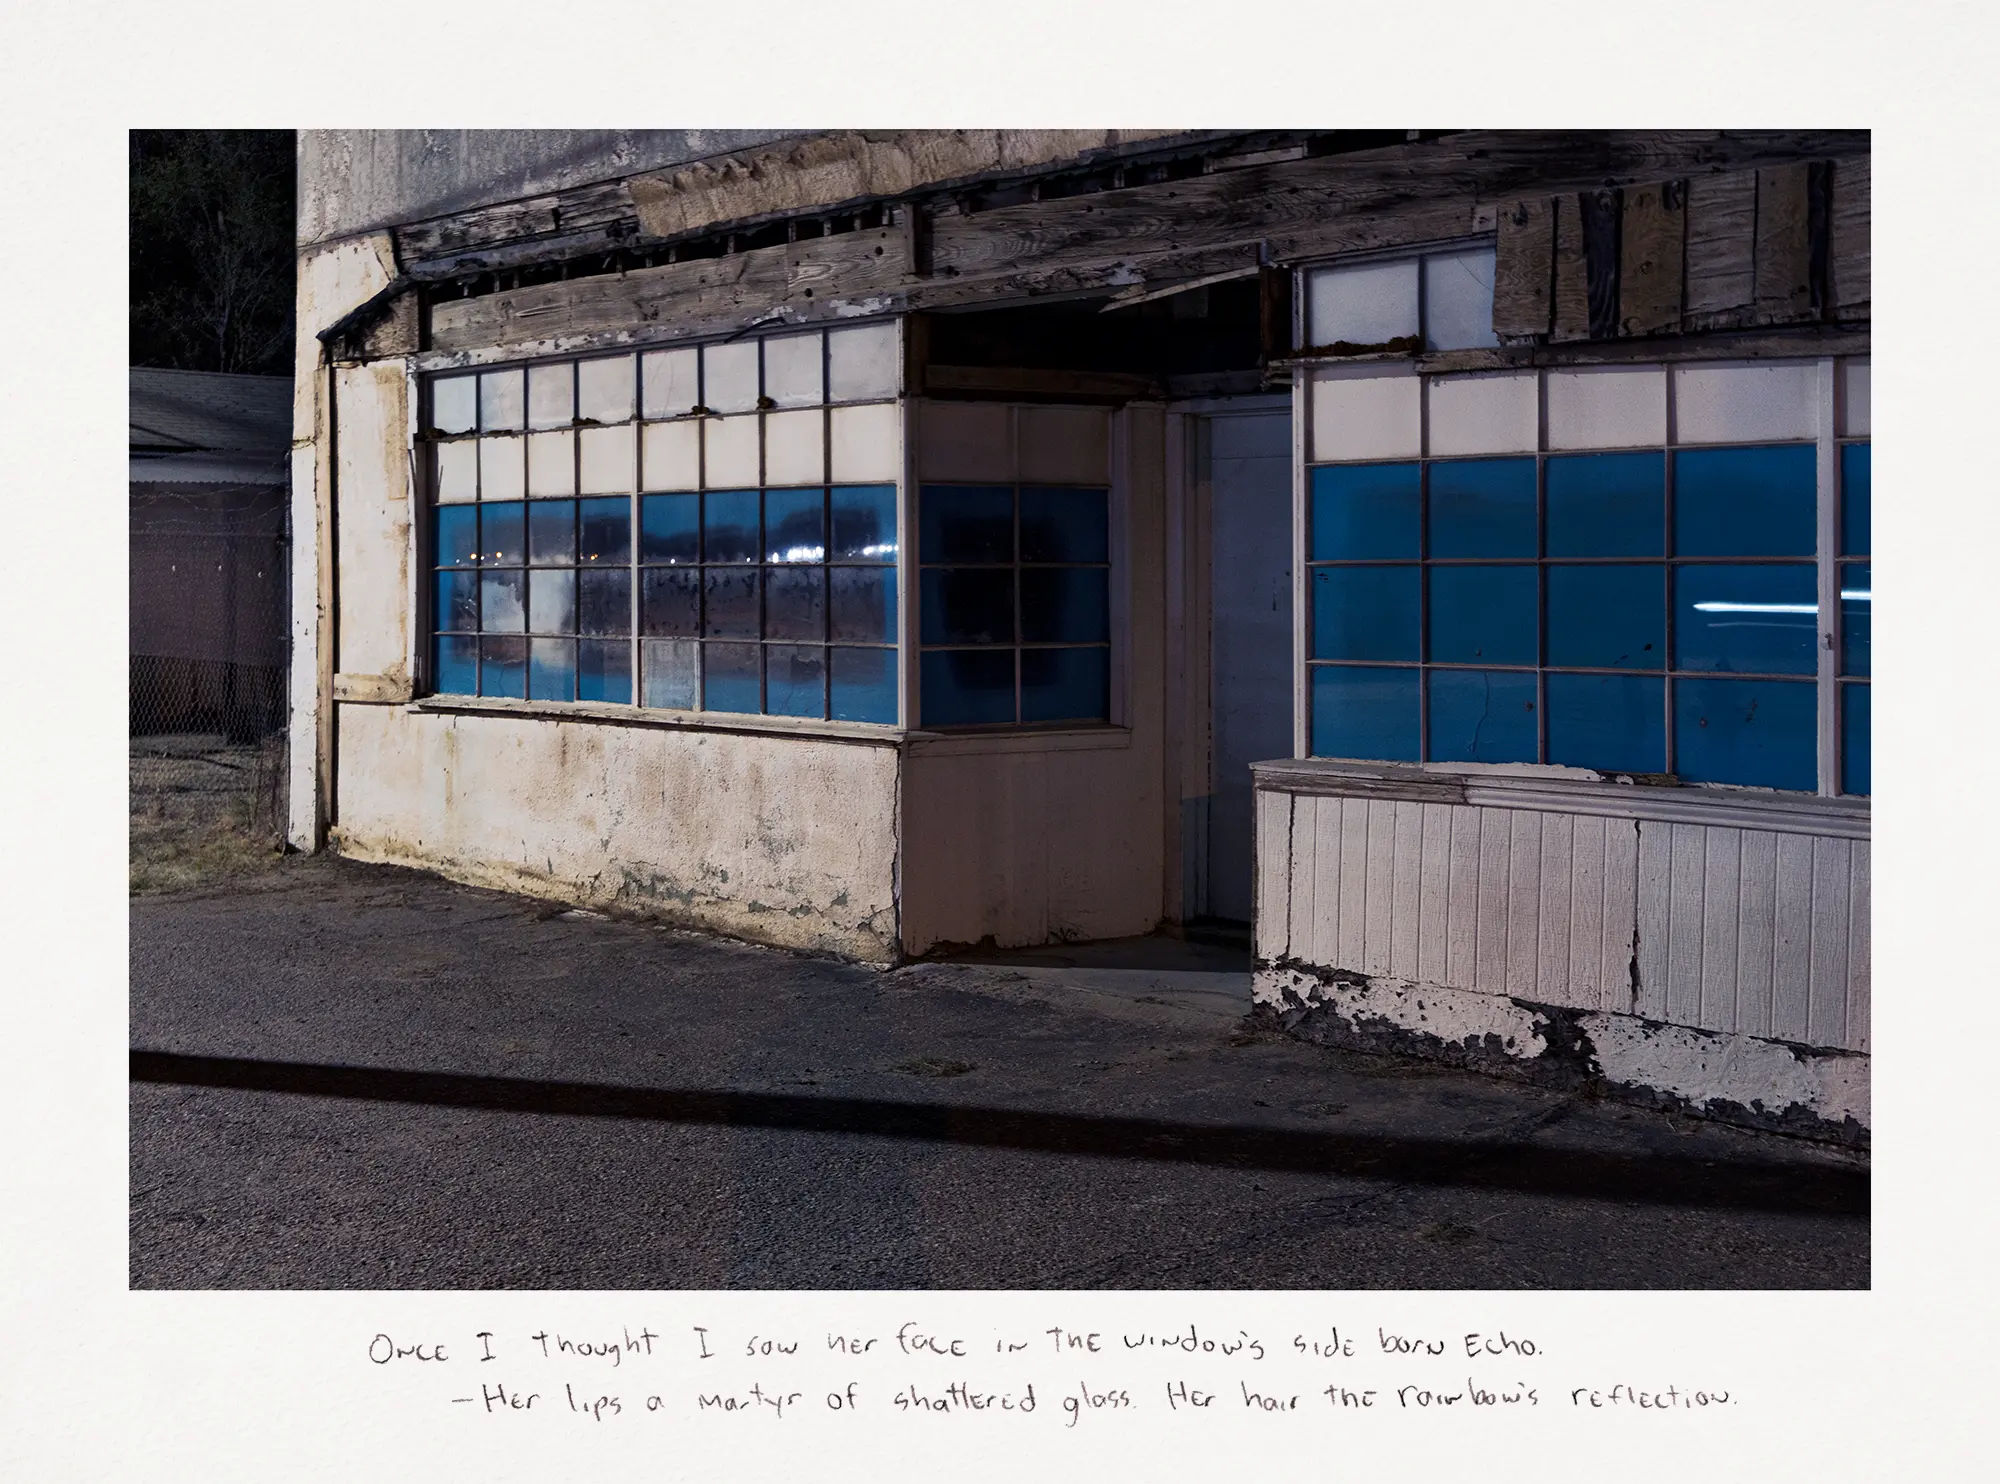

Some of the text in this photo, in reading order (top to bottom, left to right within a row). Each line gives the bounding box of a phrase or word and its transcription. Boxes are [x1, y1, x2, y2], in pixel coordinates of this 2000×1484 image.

[475, 1331, 497, 1363] I
[531, 1325, 660, 1368] thought
[692, 1326, 716, 1360] I
[745, 1335, 799, 1357] saw
[827, 1332, 879, 1355] her
[895, 1321, 967, 1357] face
[993, 1327, 1028, 1353] in
[1293, 1326, 1356, 1358] side
[565, 1383, 622, 1423] lips
[646, 1395, 666, 1412] a
[698, 1382, 803, 1419] martyr
[826, 1381, 859, 1411] of
[893, 1381, 1037, 1414] shattered
[1166, 1380, 1217, 1411] Her
[1240, 1379, 1301, 1412] hair
